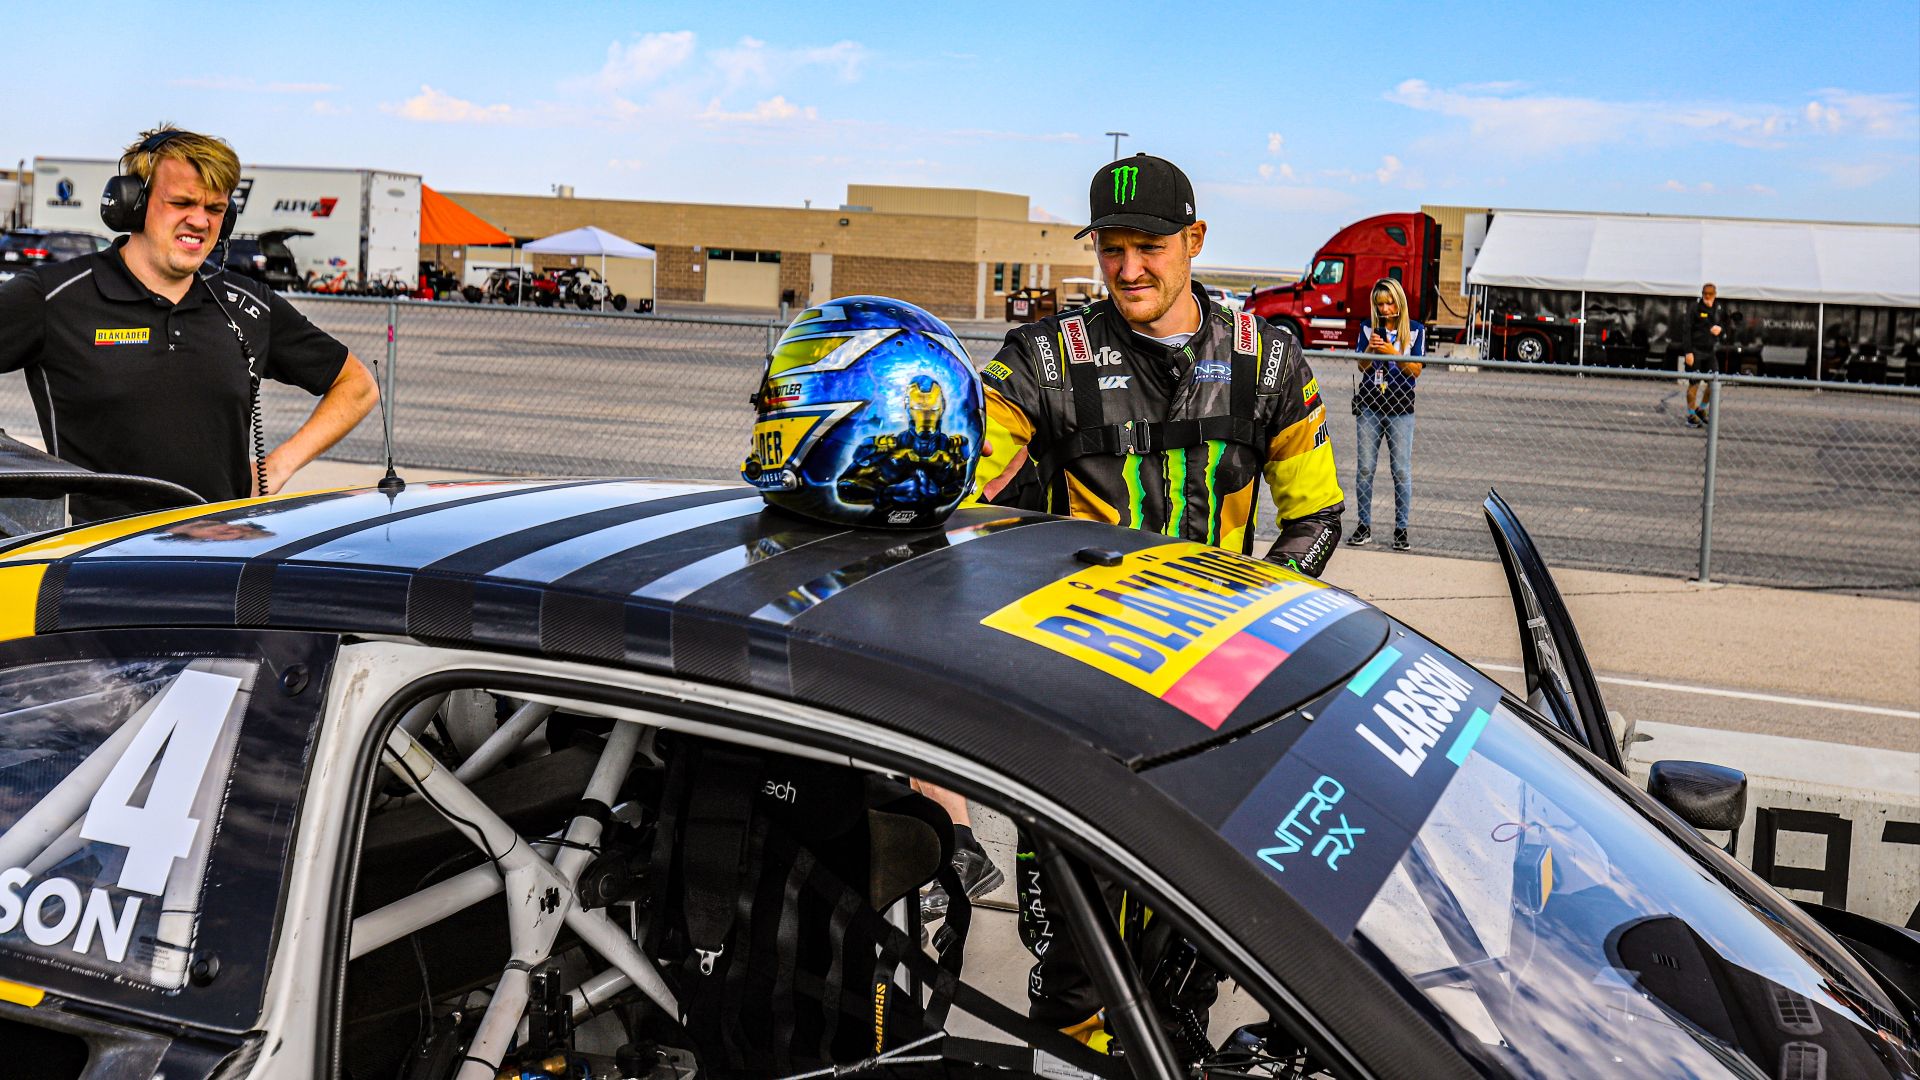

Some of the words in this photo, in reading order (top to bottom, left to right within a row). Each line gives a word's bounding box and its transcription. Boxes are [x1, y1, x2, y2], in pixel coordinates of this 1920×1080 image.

[1067, 322, 1087, 361] SIMPSON
[1240, 313, 1252, 351] SIMPSON
[1762, 318, 1816, 330] YOKOHAMA
[1035, 335, 1058, 382] sparco
[1263, 339, 1285, 389] sparco
[1355, 652, 1475, 778] LARSSON
[79, 669, 243, 897] 4
[761, 780, 797, 804] ech
[1256, 775, 1346, 872] NITRO
[1311, 813, 1366, 872] RX
